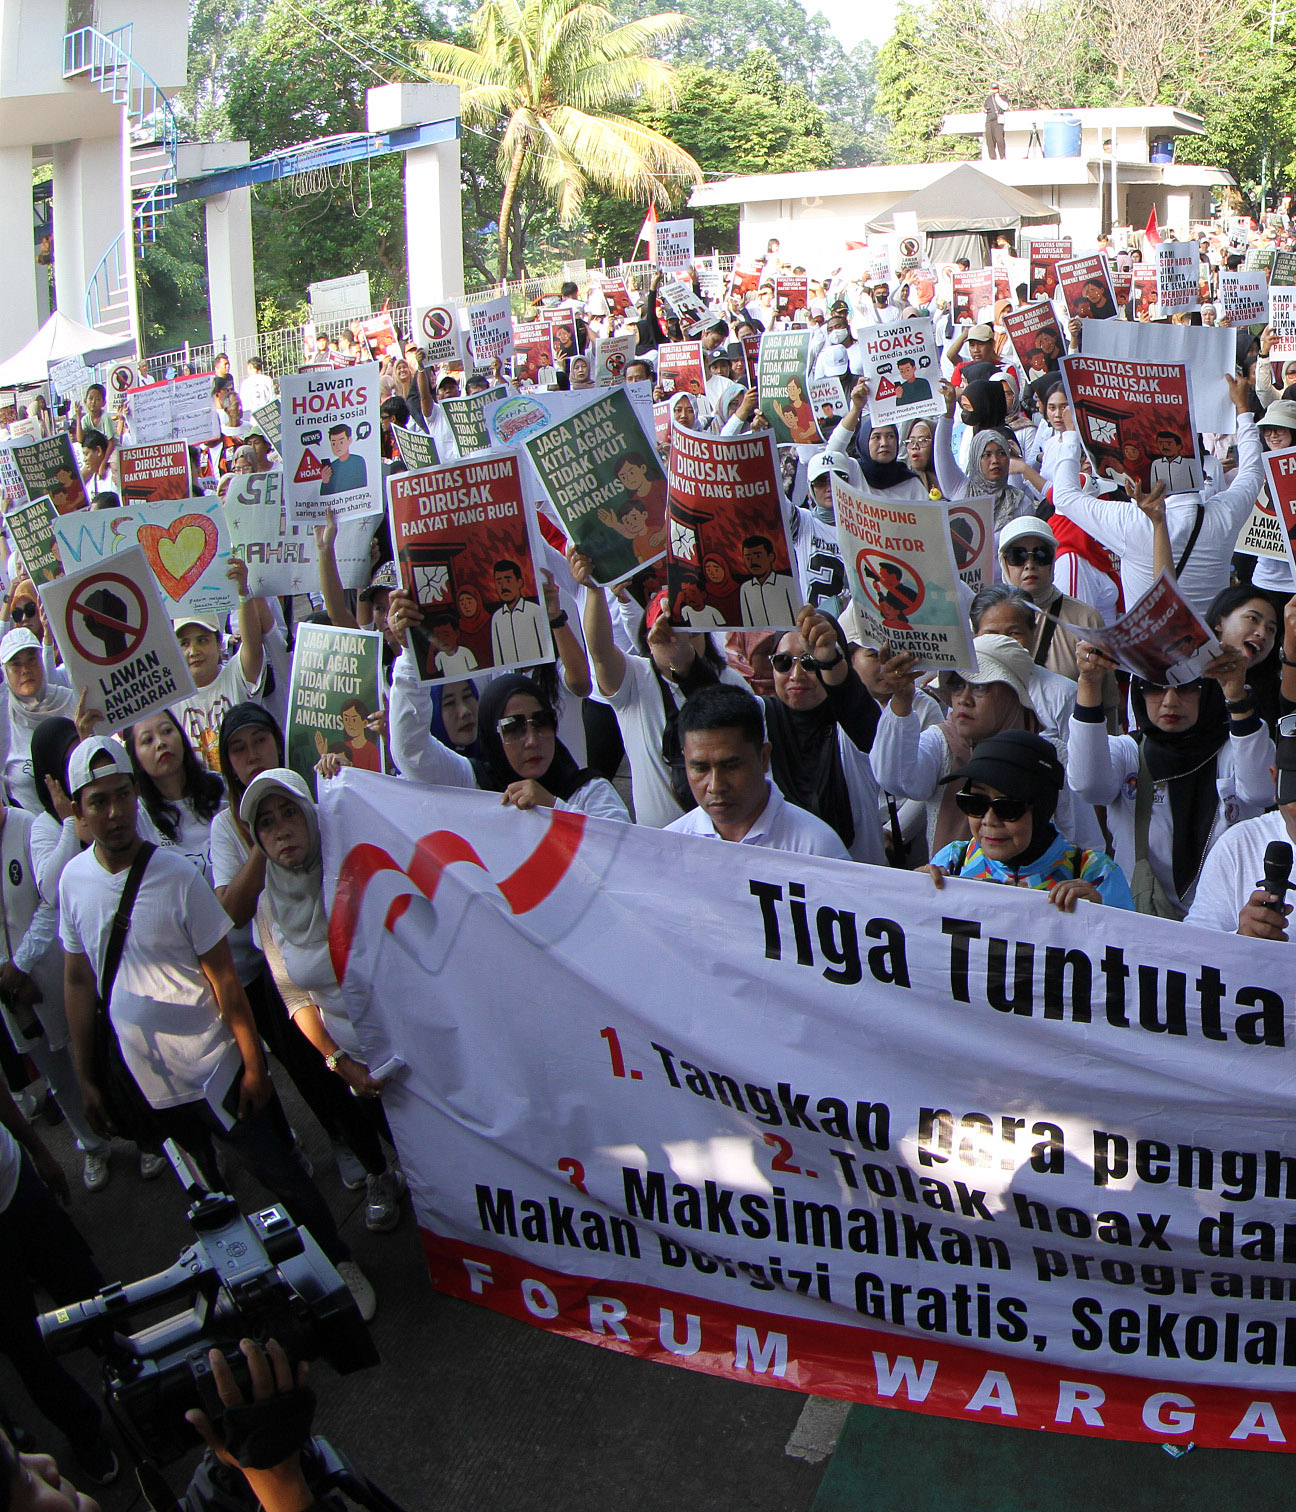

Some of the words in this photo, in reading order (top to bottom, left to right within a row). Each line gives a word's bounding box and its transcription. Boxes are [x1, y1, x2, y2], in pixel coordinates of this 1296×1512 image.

[1272, 295, 1293, 303] KAMI
[1273, 312, 1290, 320] JIKA
[292, 386, 367, 415] HOAKS
[308, 378, 352, 392] Lawan
[296, 416, 304, 425] di
[308, 413, 337, 424] media
[340, 406, 366, 420] sosial
[537, 426, 572, 456] JAGA
[573, 398, 616, 434] ANAK
[302, 434, 320, 442] NEWS
[541, 445, 576, 472] KITA
[576, 420, 616, 454] AGAR
[300, 468, 321, 478] HOAX
[548, 454, 594, 488] TIDAK
[592, 433, 627, 464] IKUT
[396, 470, 462, 498] FASILITAS
[466, 461, 512, 484] UMUM
[556, 474, 598, 506] DEMO
[296, 500, 318, 510] Jangan
[320, 498, 344, 508] mudah
[346, 493, 372, 504] percaya,
[419, 484, 493, 516] DIRUSAK
[566, 479, 625, 522] ANARKIS
[856, 500, 916, 525] KAMPUNG
[402, 514, 448, 536] RAKYAT
[451, 508, 484, 526] YANG
[488, 502, 518, 520] RUGI
[840, 515, 925, 552] PROVOKATOR
[856, 514, 880, 532] DARI
[234, 541, 310, 564] MAHAL
[304, 632, 330, 649] JAGA
[332, 636, 366, 655] ANAK
[99, 650, 160, 696] LAWAN
[302, 650, 324, 668] KITA
[326, 656, 358, 674] AGAR
[104, 670, 164, 712] ANARKIS
[162, 666, 172, 676] &
[299, 670, 331, 690] TIDAK
[334, 678, 362, 695] IKUT
[106, 678, 177, 724] PENJARAH
[297, 690, 327, 710] DEMO
[295, 708, 345, 730] ANARKIS
[748, 880, 912, 988] Tiga
[600, 1026, 643, 1080] 1.
[650, 1041, 890, 1152] Tangkap
[918, 1106, 1064, 1174] para
[763, 1132, 819, 1178] 2.
[829, 1148, 996, 1222] Tolak
[1012, 1192, 1172, 1251] hoax
[622, 1166, 1011, 1270] Maksimalkan
[475, 1184, 641, 1259] Makan
[855, 1272, 1047, 1352] Gratis,
[462, 1260, 789, 1376] FORUM
[873, 1350, 1287, 1442] WARGA
